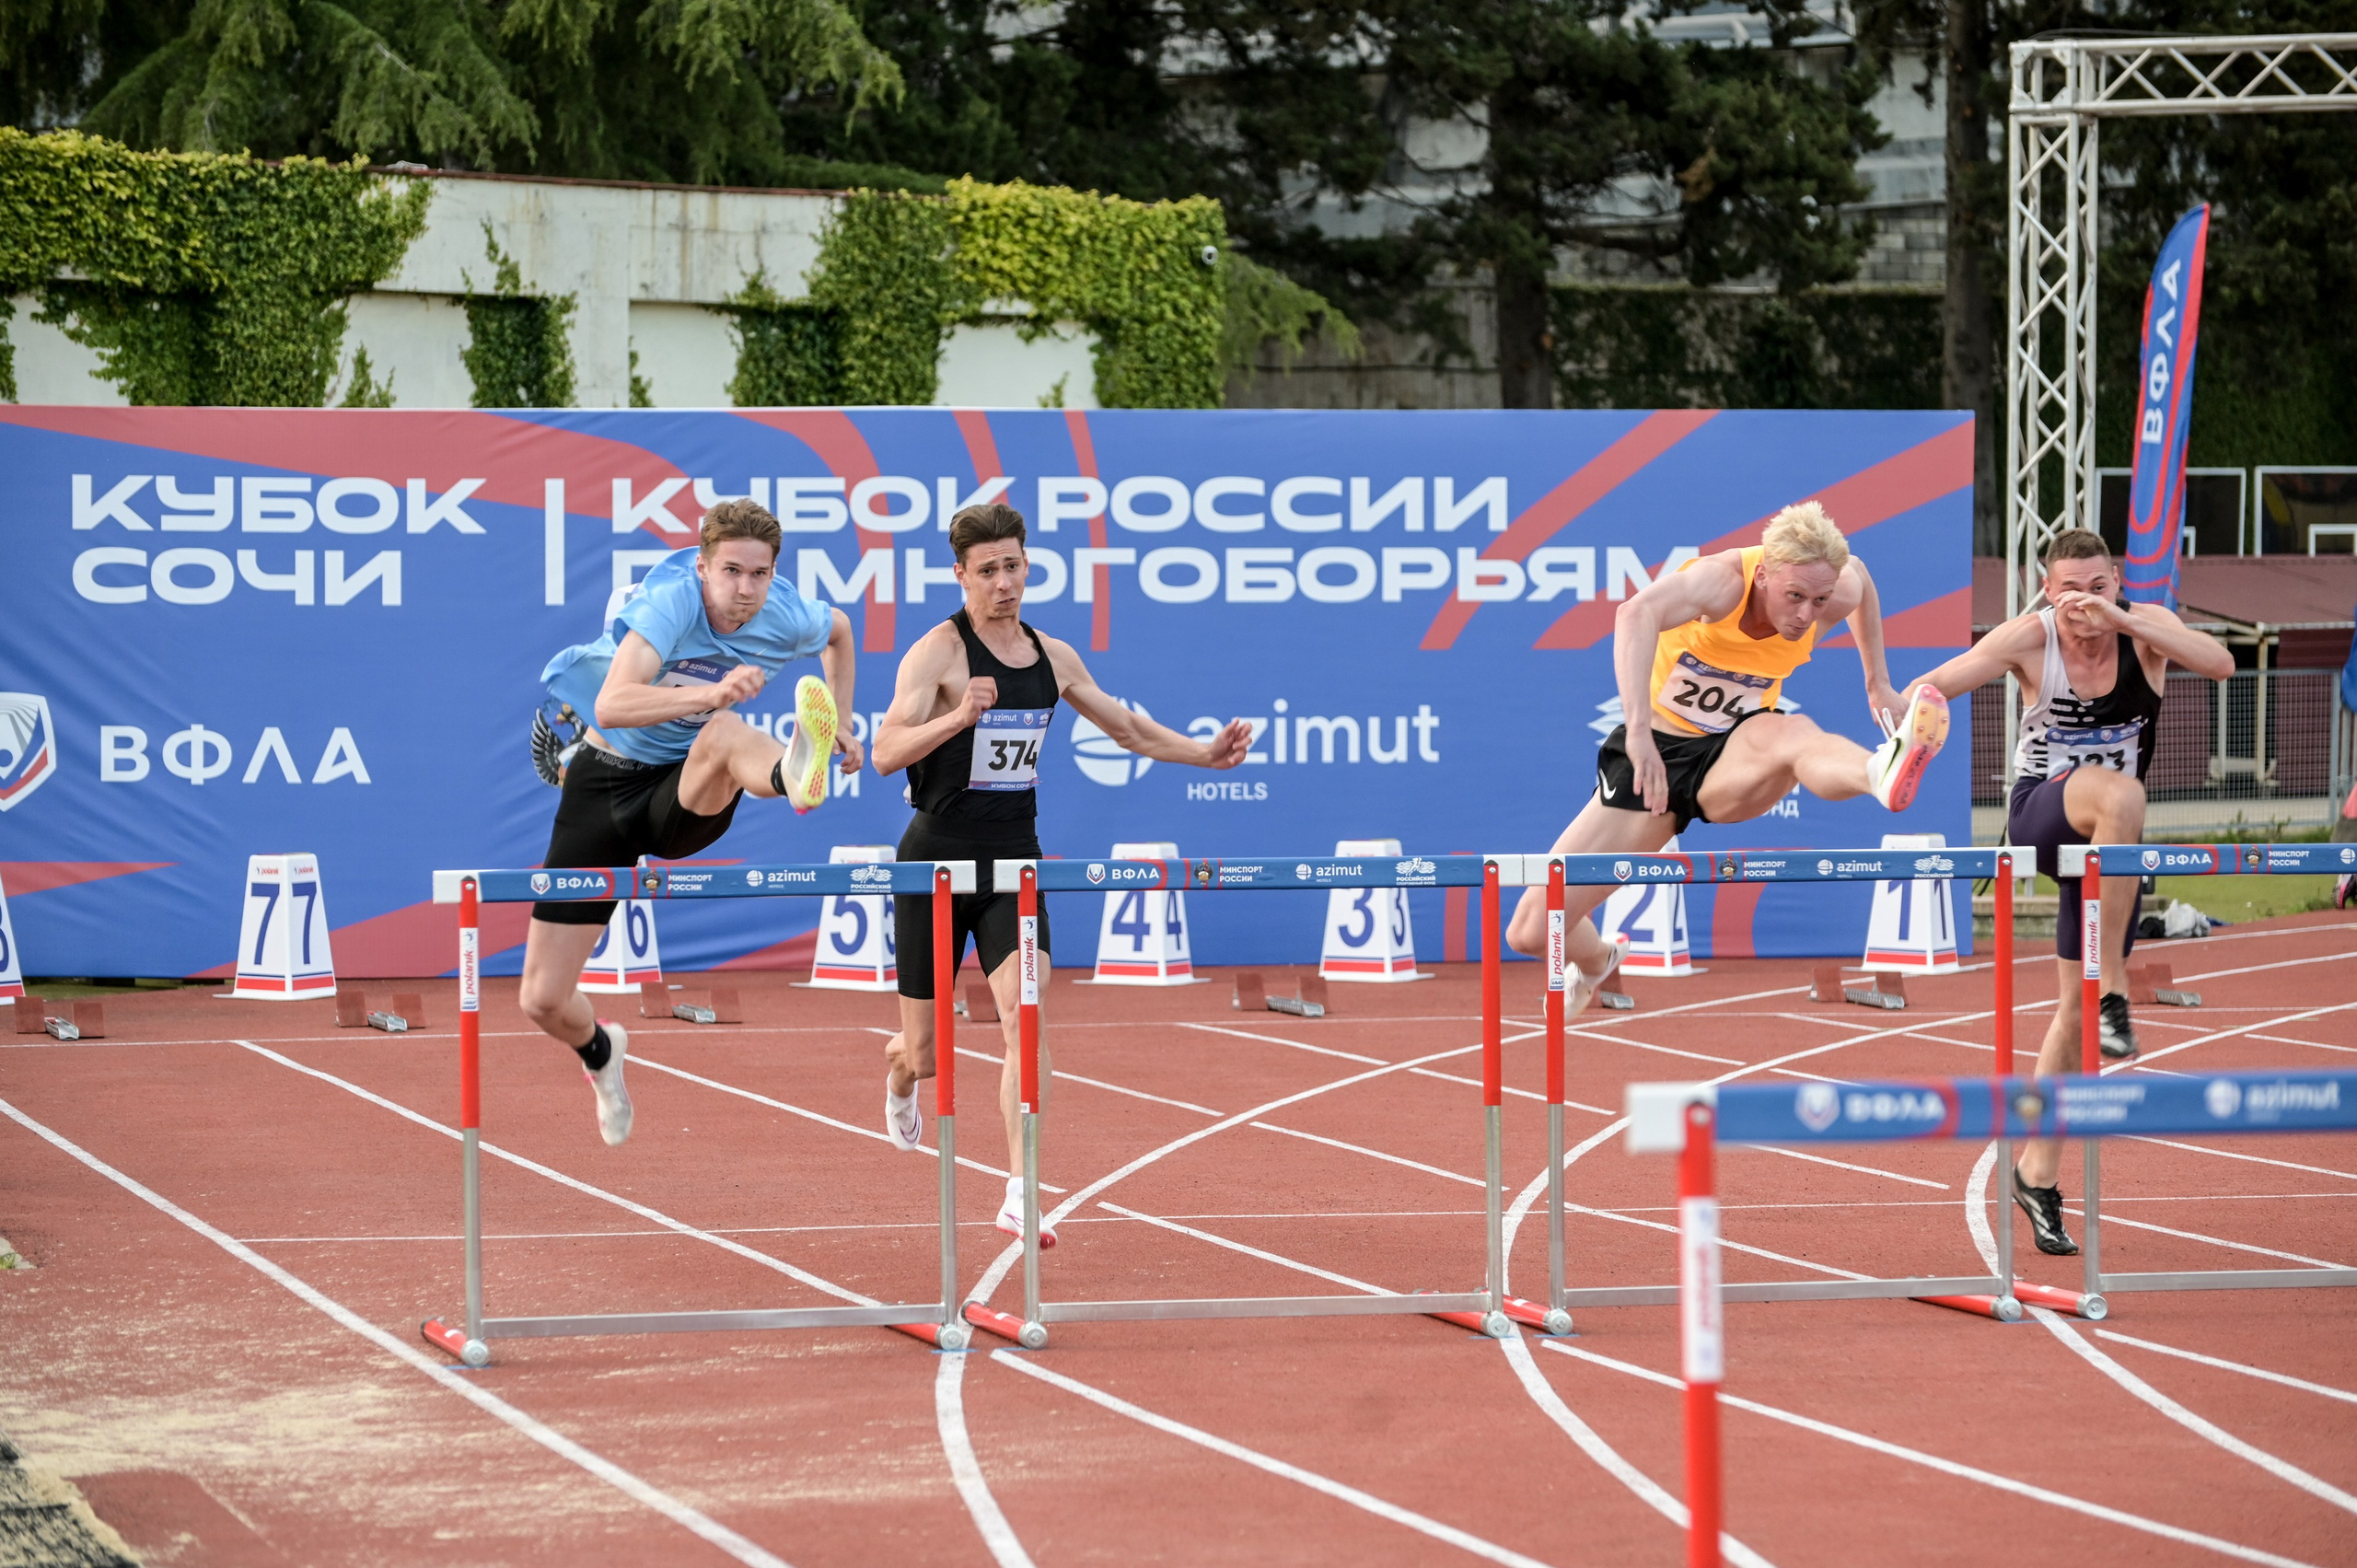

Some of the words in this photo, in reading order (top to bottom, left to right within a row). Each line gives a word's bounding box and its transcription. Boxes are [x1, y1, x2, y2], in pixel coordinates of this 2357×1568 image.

[2141, 258, 2181, 444] ВФЛА
[72, 474, 487, 534] КУБОК
[611, 476, 1016, 533] КУБОК
[1038, 475, 1507, 532] РОССИИ
[72, 546, 402, 606] СОЧИ
[689, 662, 718, 676] azimut
[993, 713, 1017, 722] azimut
[1672, 679, 1745, 719] 204
[1187, 698, 1440, 764] azimut
[100, 724, 371, 785] ВФЛА
[988, 739, 1038, 771] 374
[1187, 782, 1268, 801] HOTELS
[768, 868, 816, 882] azimut
[1111, 867, 1160, 880] ВФЛА
[1219, 865, 1263, 874] МИНСПОРТ
[1316, 864, 1363, 876] azimut
[1638, 865, 1686, 877] ВФЛА
[1744, 861, 1786, 869] МИНСПОРТ
[1744, 869, 1776, 877] РОССИИ
[1837, 860, 1883, 872] azimut
[2165, 853, 2212, 865] ВФЛА
[2269, 850, 2310, 858] МИНСПОРТ
[2269, 858, 2300, 866] РОССИИ
[557, 877, 607, 889] ВФЛА
[668, 874, 713, 882] МИНСПОРТ
[668, 883, 702, 891] РОССИИ
[1219, 875, 1253, 883] РОССИИ
[250, 881, 281, 966] 7
[292, 880, 318, 965] 7
[626, 900, 648, 958] 6
[830, 895, 868, 956] 5
[1111, 890, 1151, 953] 4
[1167, 890, 1182, 951] 4
[1338, 888, 1375, 948] 3
[1393, 888, 1406, 947] 3
[1617, 884, 1656, 943] 2
[1887, 879, 1913, 941] 1
[1934, 878, 1947, 941] 1
[1026, 936, 1036, 982] polanik
[1551, 930, 1563, 976] polanik
[2088, 921, 2099, 965] polanik
[465, 949, 474, 995] polanik
